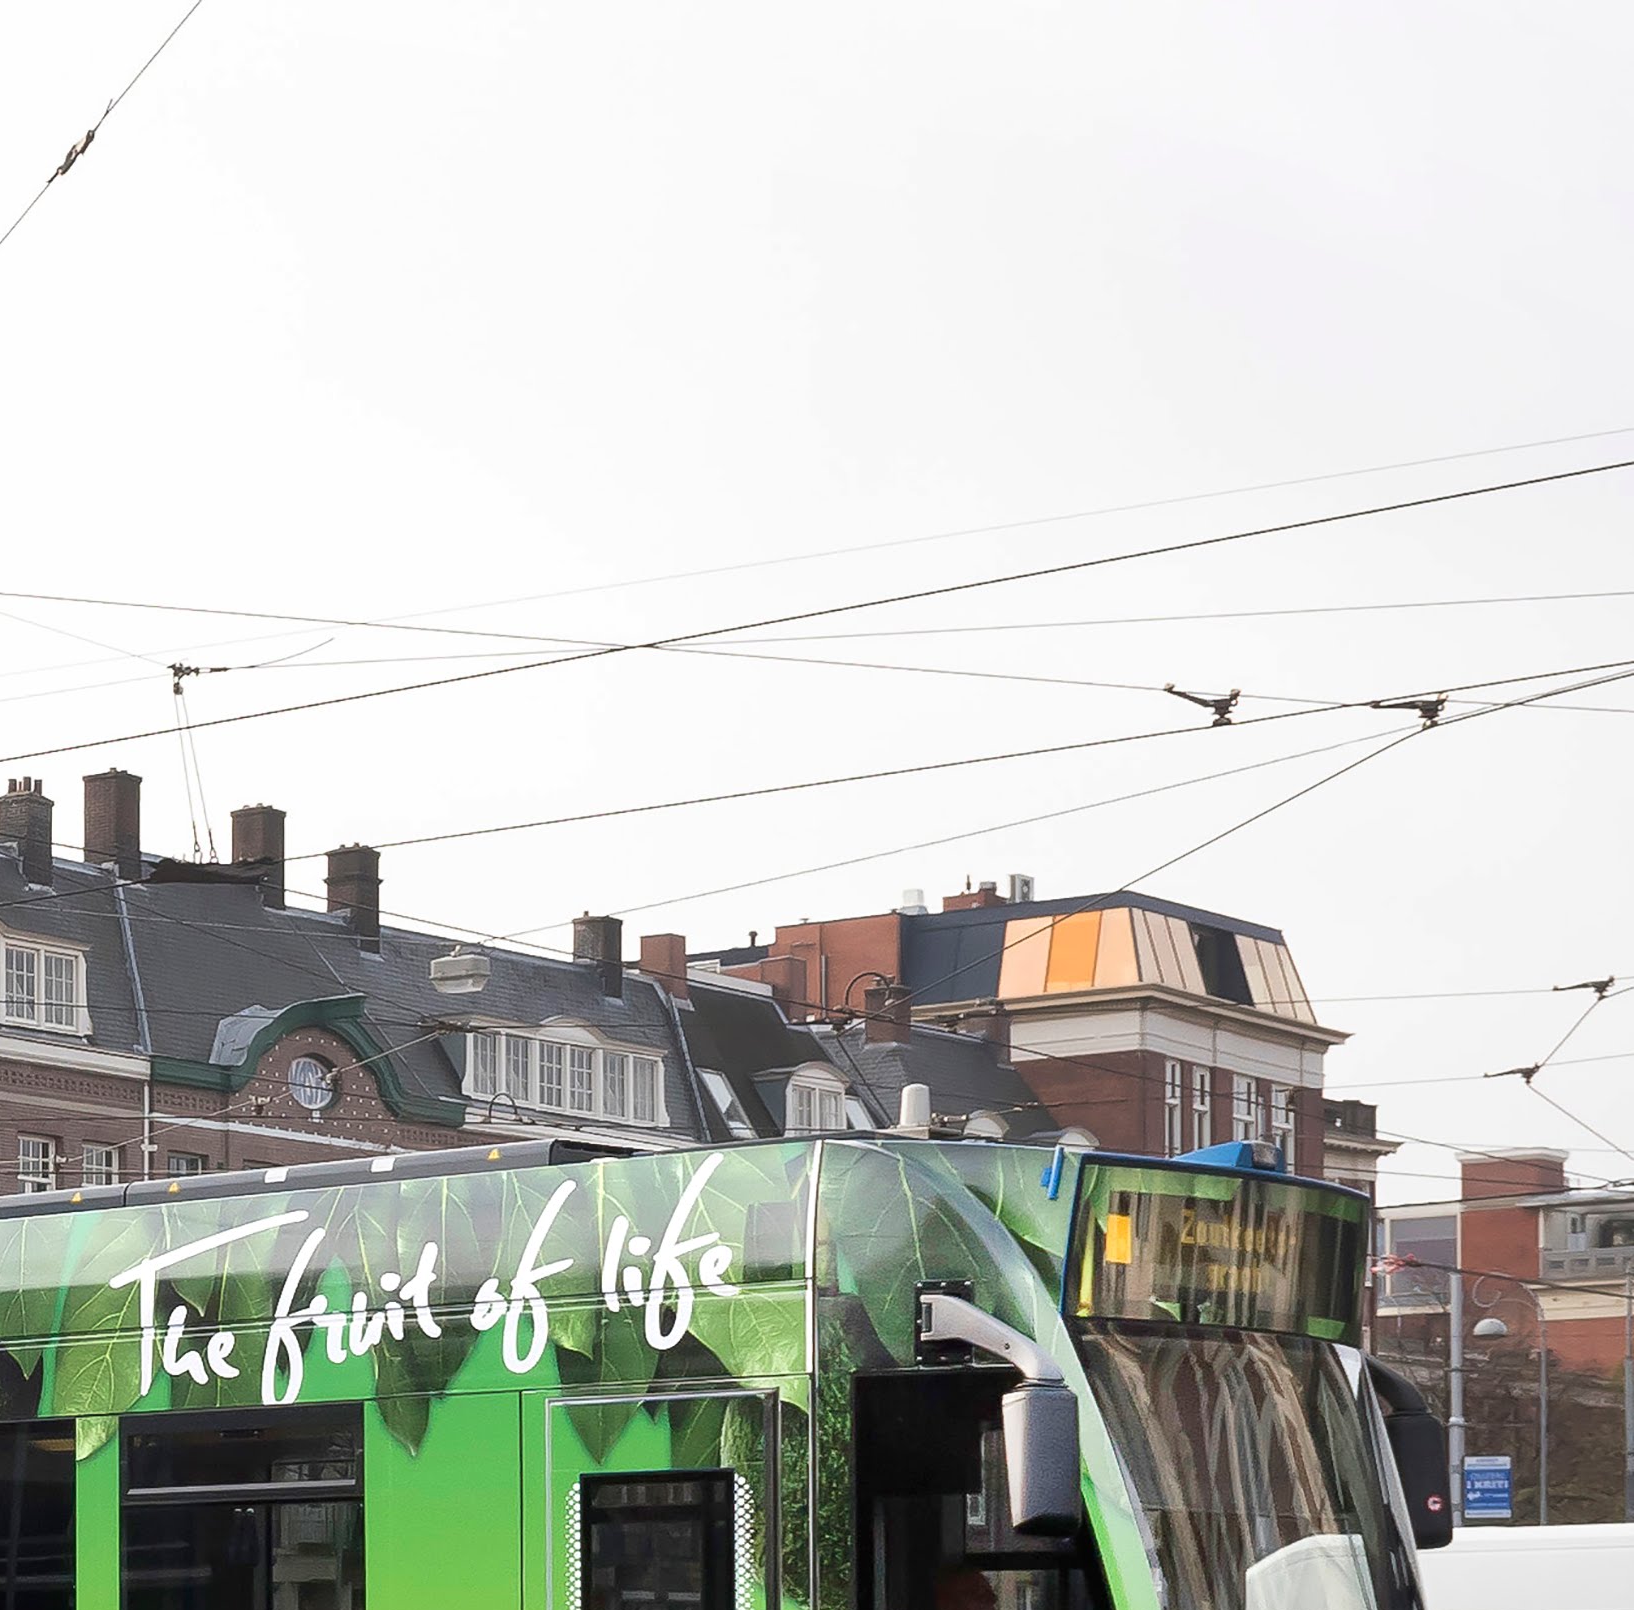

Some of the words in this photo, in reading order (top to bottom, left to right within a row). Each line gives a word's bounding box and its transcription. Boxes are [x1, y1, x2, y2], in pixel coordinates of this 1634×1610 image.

[109, 1208, 309, 1397] The
[260, 1226, 441, 1406] fruit
[469, 1179, 577, 1374] of
[601, 1153, 741, 1351] life
